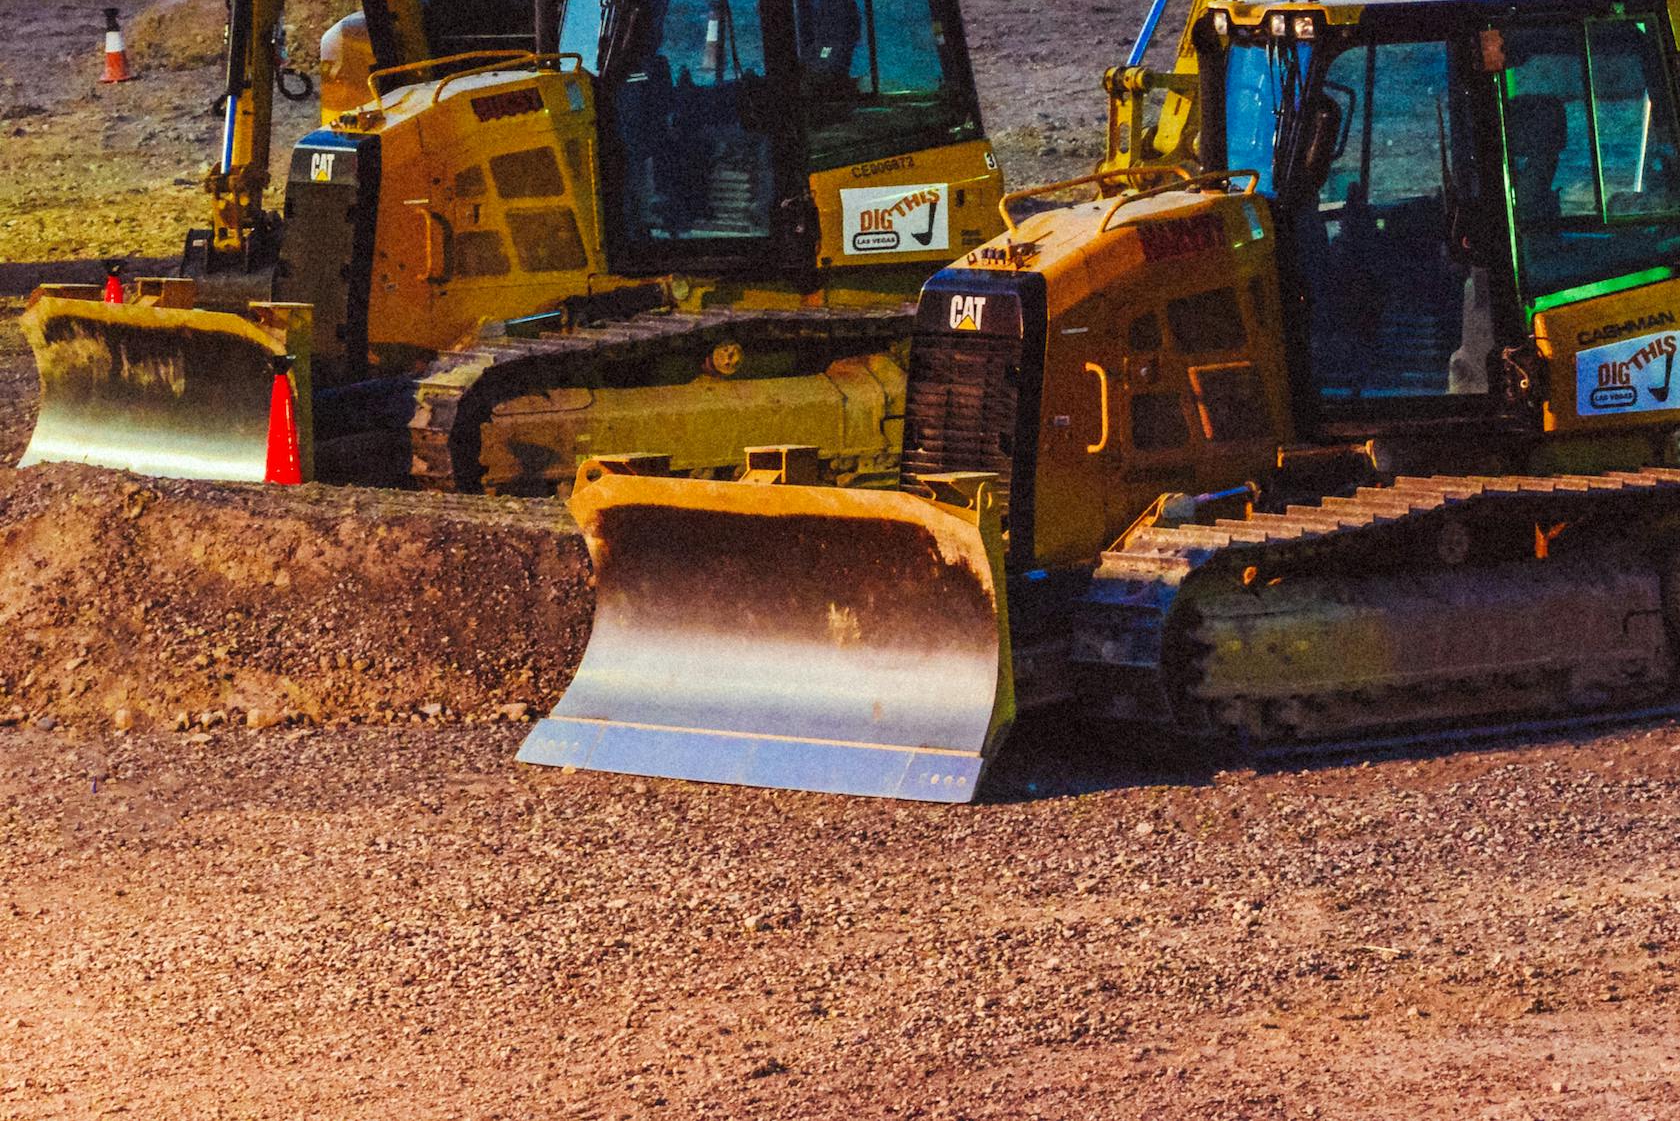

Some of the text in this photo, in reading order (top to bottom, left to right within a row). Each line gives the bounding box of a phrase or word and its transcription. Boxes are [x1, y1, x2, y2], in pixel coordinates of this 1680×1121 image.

[311, 153, 335, 181] CAT
[986, 152, 995, 168] 3
[860, 189, 940, 232] DIG THIS
[950, 295, 986, 330] CAT
[1598, 335, 1677, 386] DIG THIS
